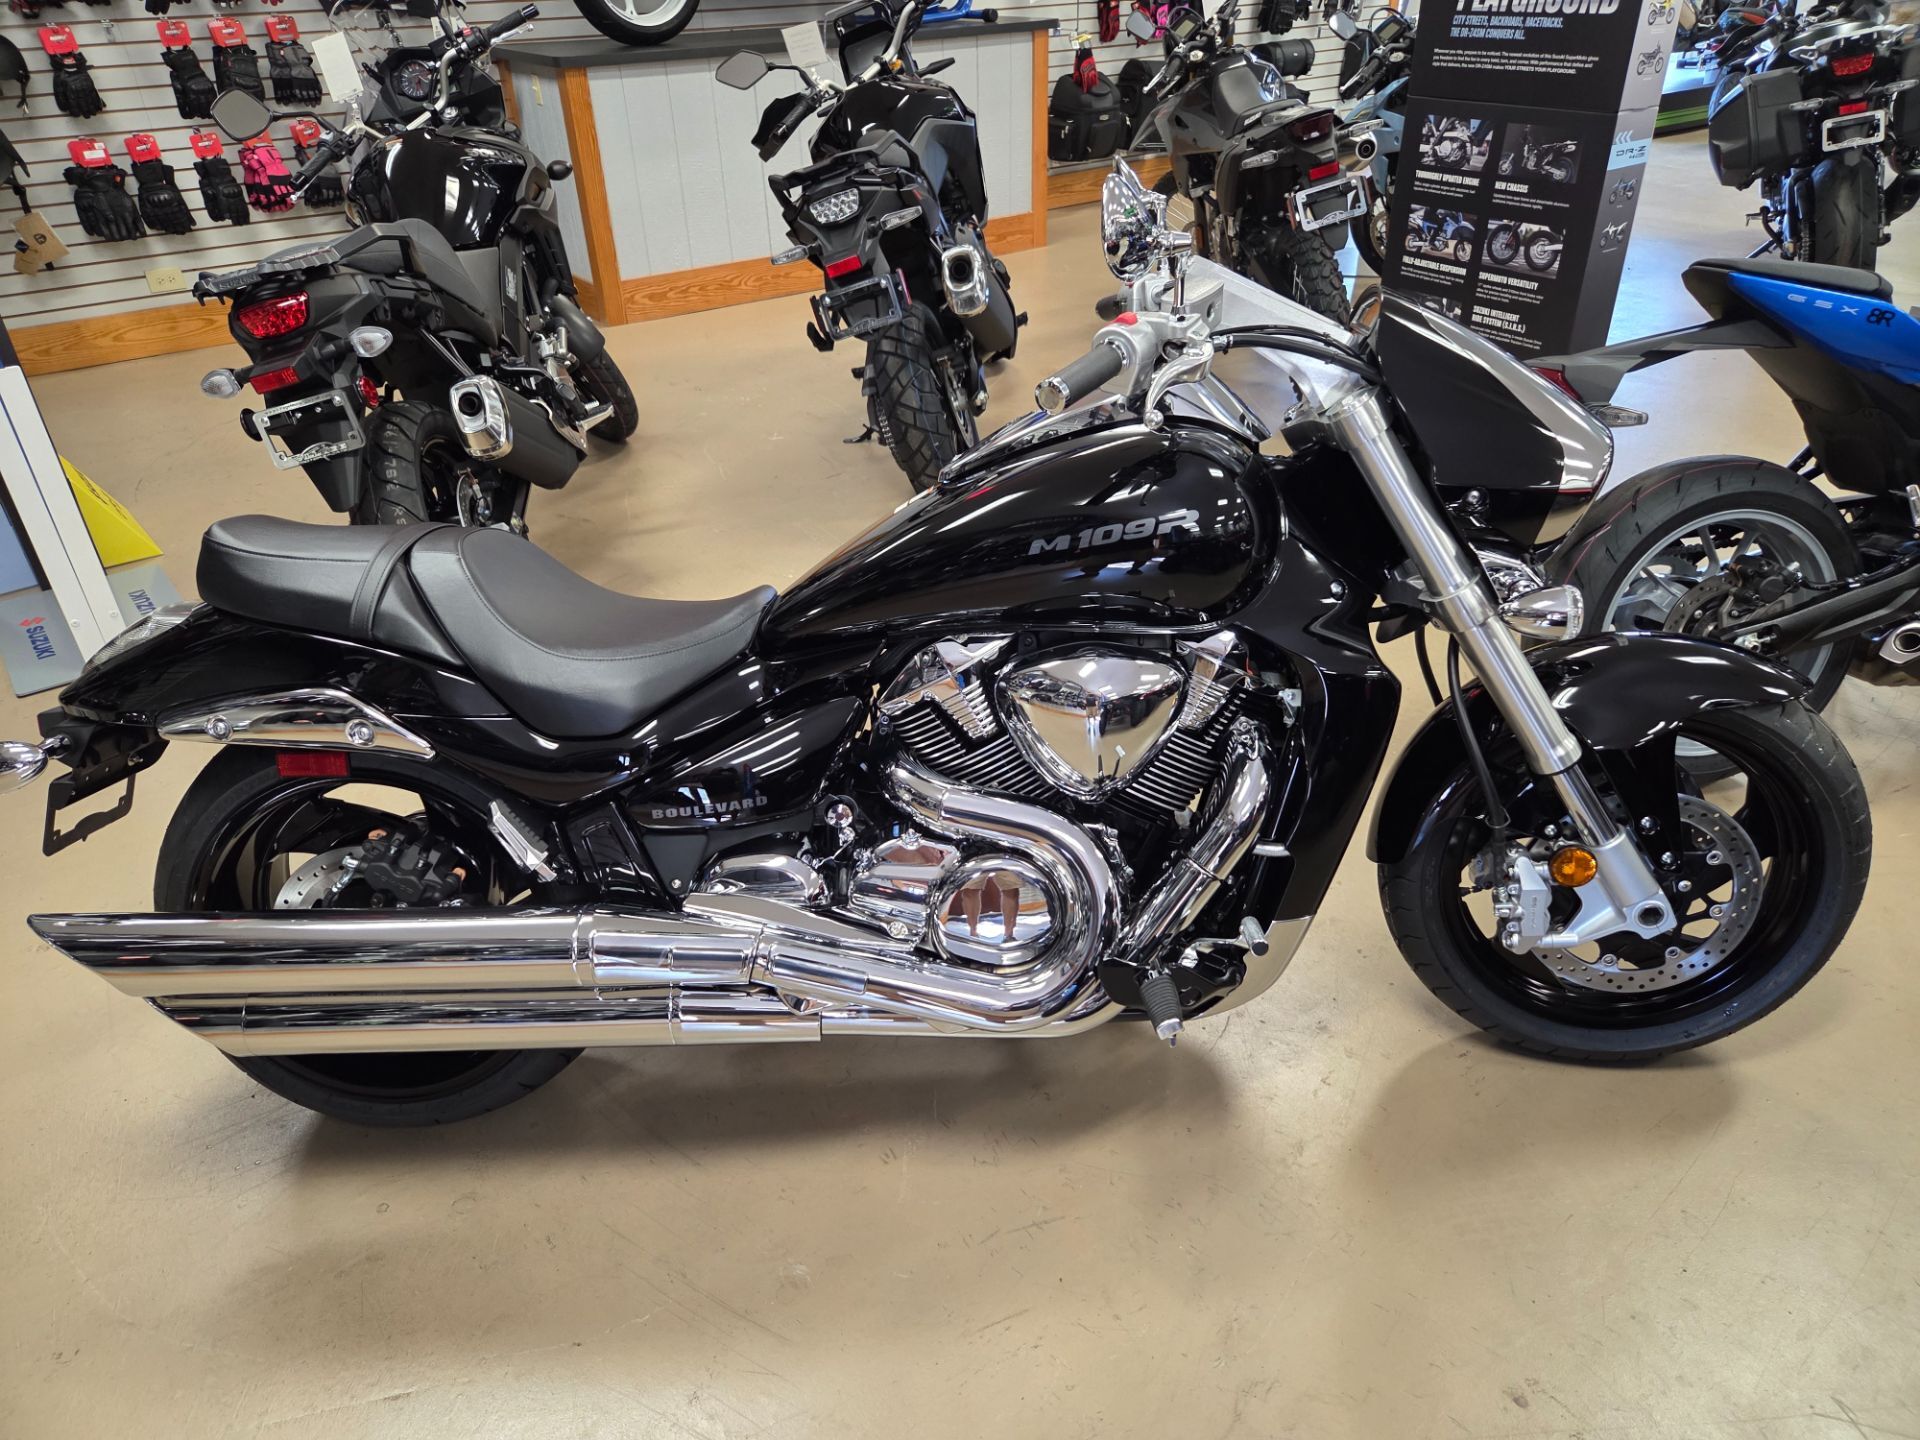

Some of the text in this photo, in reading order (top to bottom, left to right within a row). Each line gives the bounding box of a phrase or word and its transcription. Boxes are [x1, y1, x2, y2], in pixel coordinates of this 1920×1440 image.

[1452, 15, 1563, 28] CITY STREETS, BACKROADS, RACETRACKS.
[1450, 27, 1460, 37] THE
[1485, 28, 1514, 39] CONQUERS
[1494, 181, 1529, 193] NEW CHASSIS
[1866, 308, 1896, 327] 8R
[128, 589, 157, 615] UZUKI
[26, 625, 57, 660] SUZUKI
[651, 795, 769, 820] BOULEVARD
